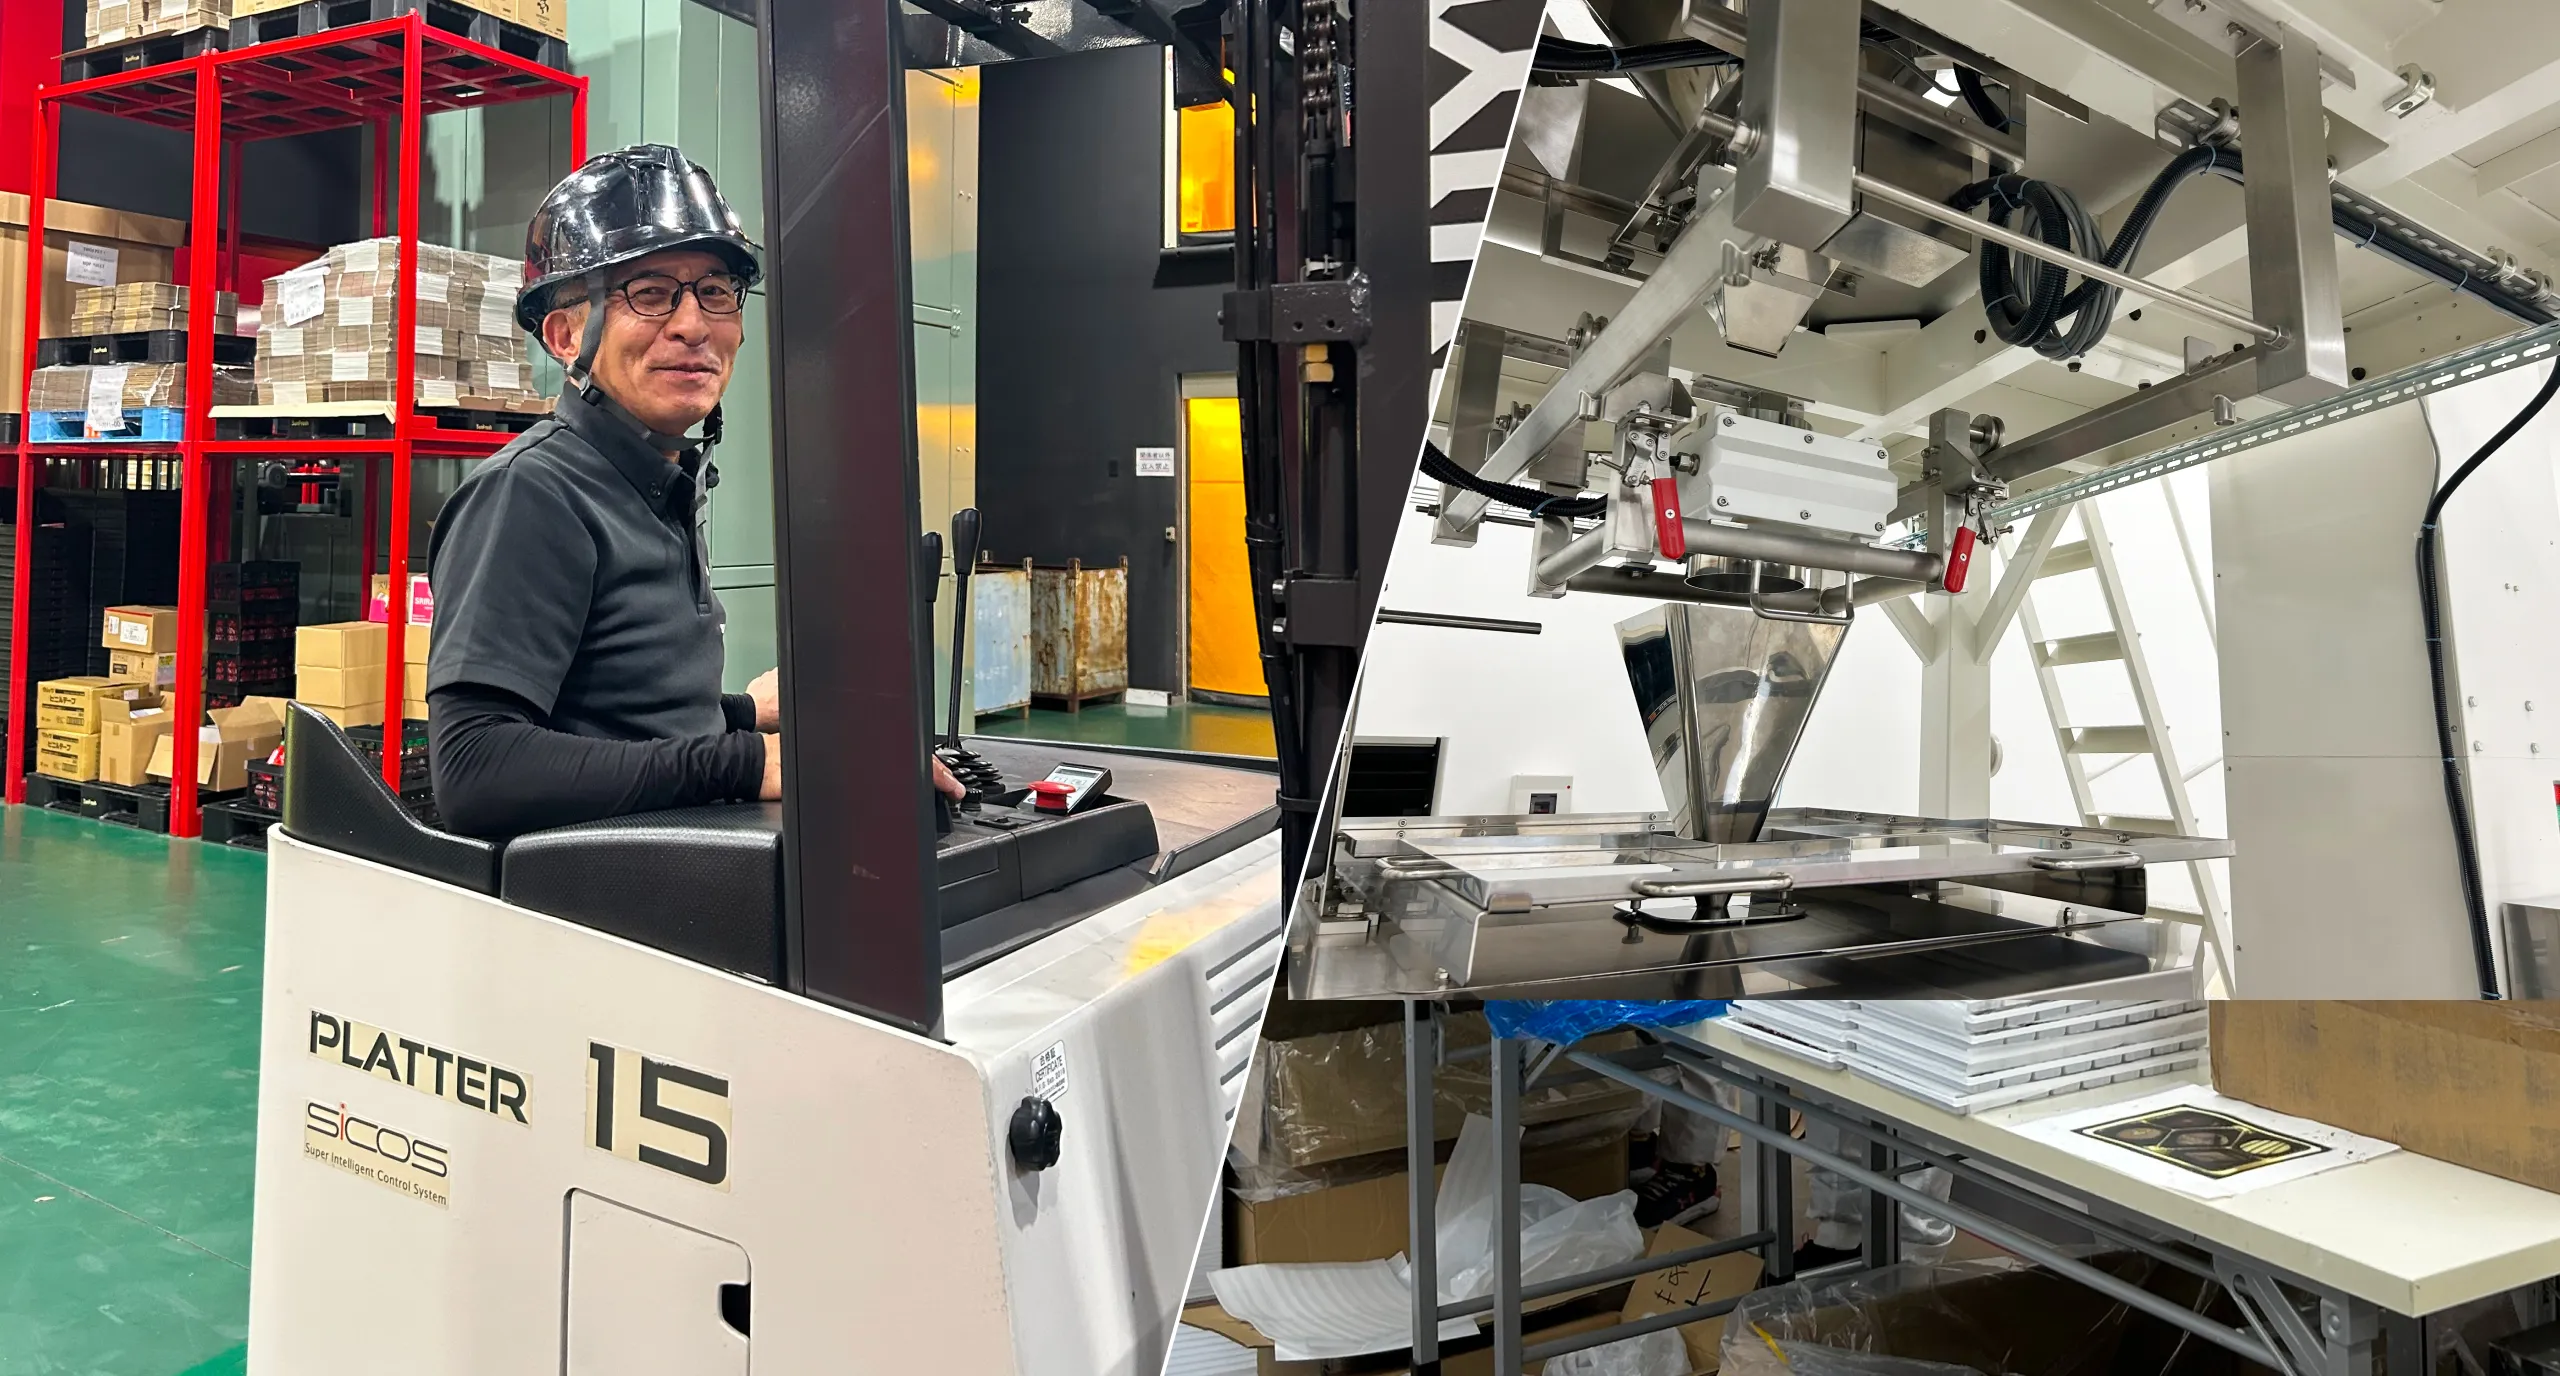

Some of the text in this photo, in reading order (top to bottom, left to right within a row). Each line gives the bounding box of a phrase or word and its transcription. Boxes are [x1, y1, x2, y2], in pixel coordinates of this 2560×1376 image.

[310, 1010, 529, 1125] PLATTER
[1036, 1055, 1063, 1082] CERTIFICATE
[590, 1041, 729, 1185] 15
[304, 1142, 447, 1206] Super Intelligent Control System
